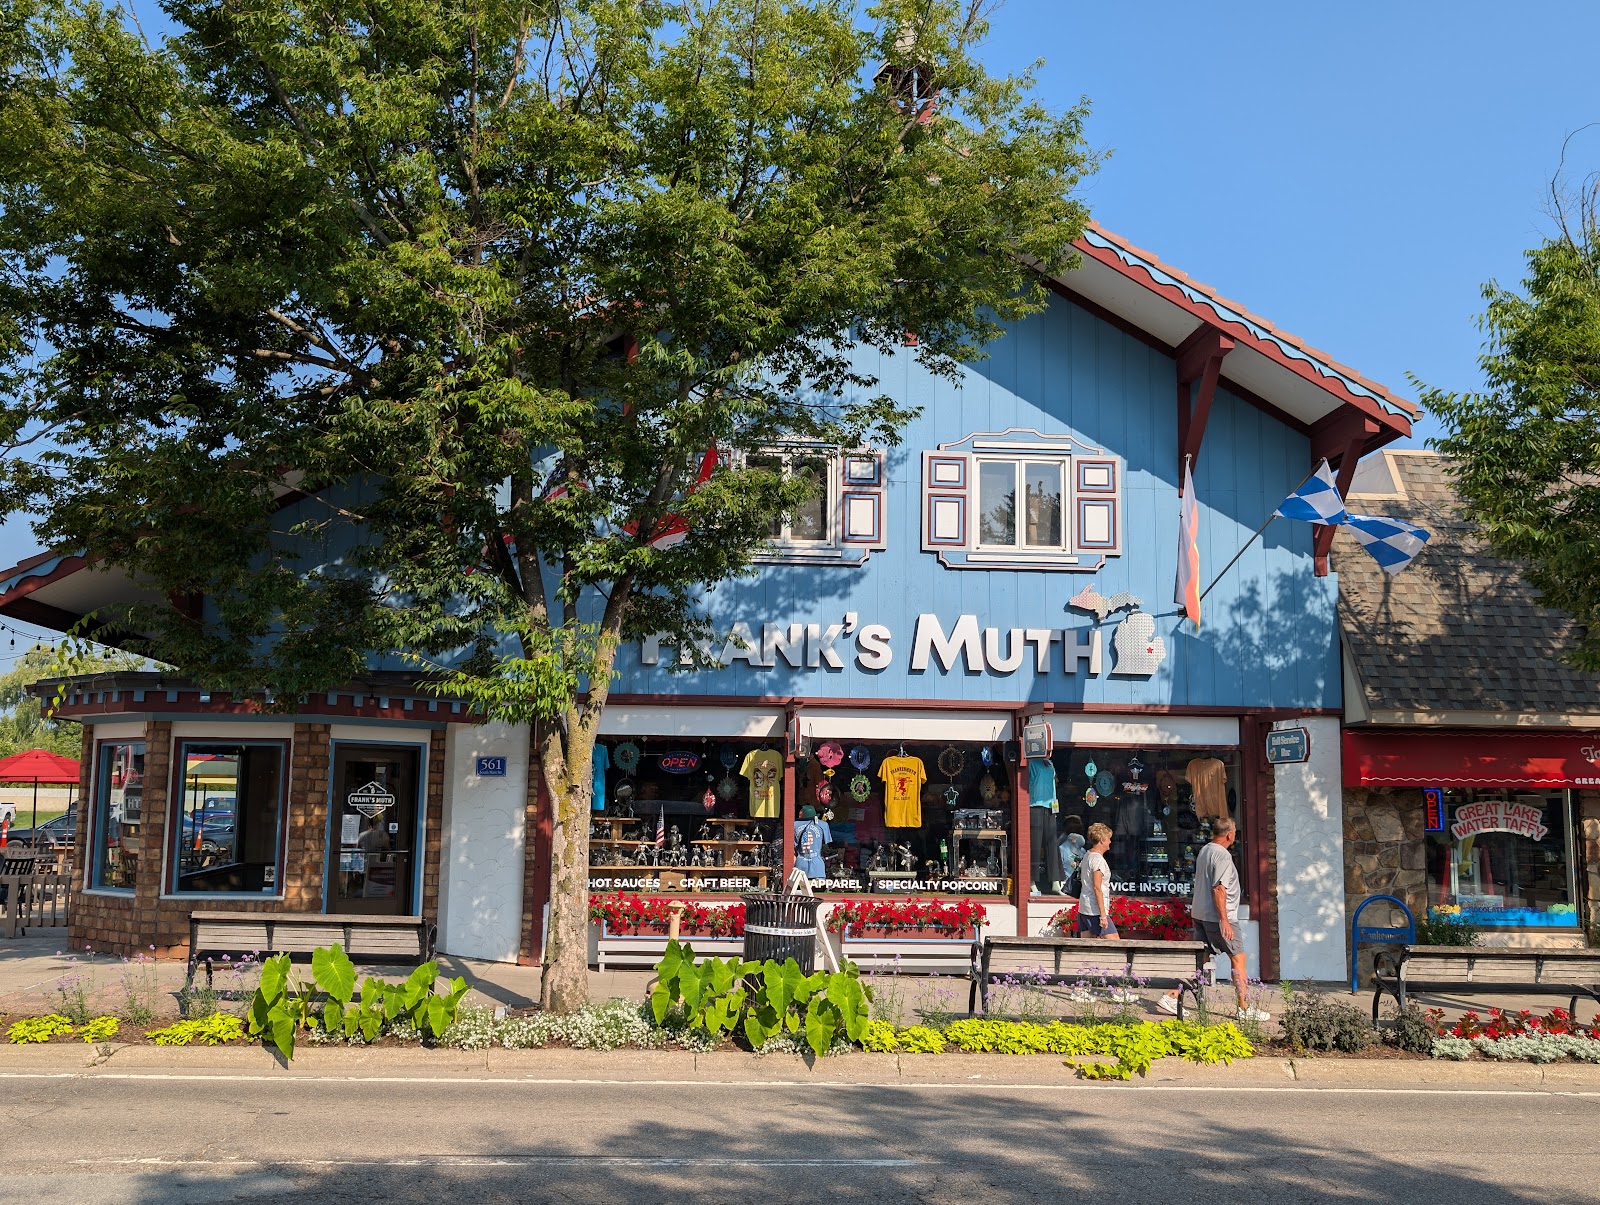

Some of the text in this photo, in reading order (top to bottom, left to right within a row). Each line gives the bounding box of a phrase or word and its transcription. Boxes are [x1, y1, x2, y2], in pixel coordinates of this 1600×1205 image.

[911, 613, 1102, 674] MUTH
[481, 758, 502, 770] 561
[661, 757, 698, 768] OPEN
[1426, 792, 1439, 829] OPEN
[1457, 803, 1541, 823] GREAT LAKE
[1453, 816, 1545, 838] WATER TAFFY
[587, 878, 751, 889] HOT SAUCES CRAFT BEER
[810, 879, 998, 891] APPAREL SPECIALTY POPCORN
[1109, 882, 1191, 893] VICE IN-STORE
